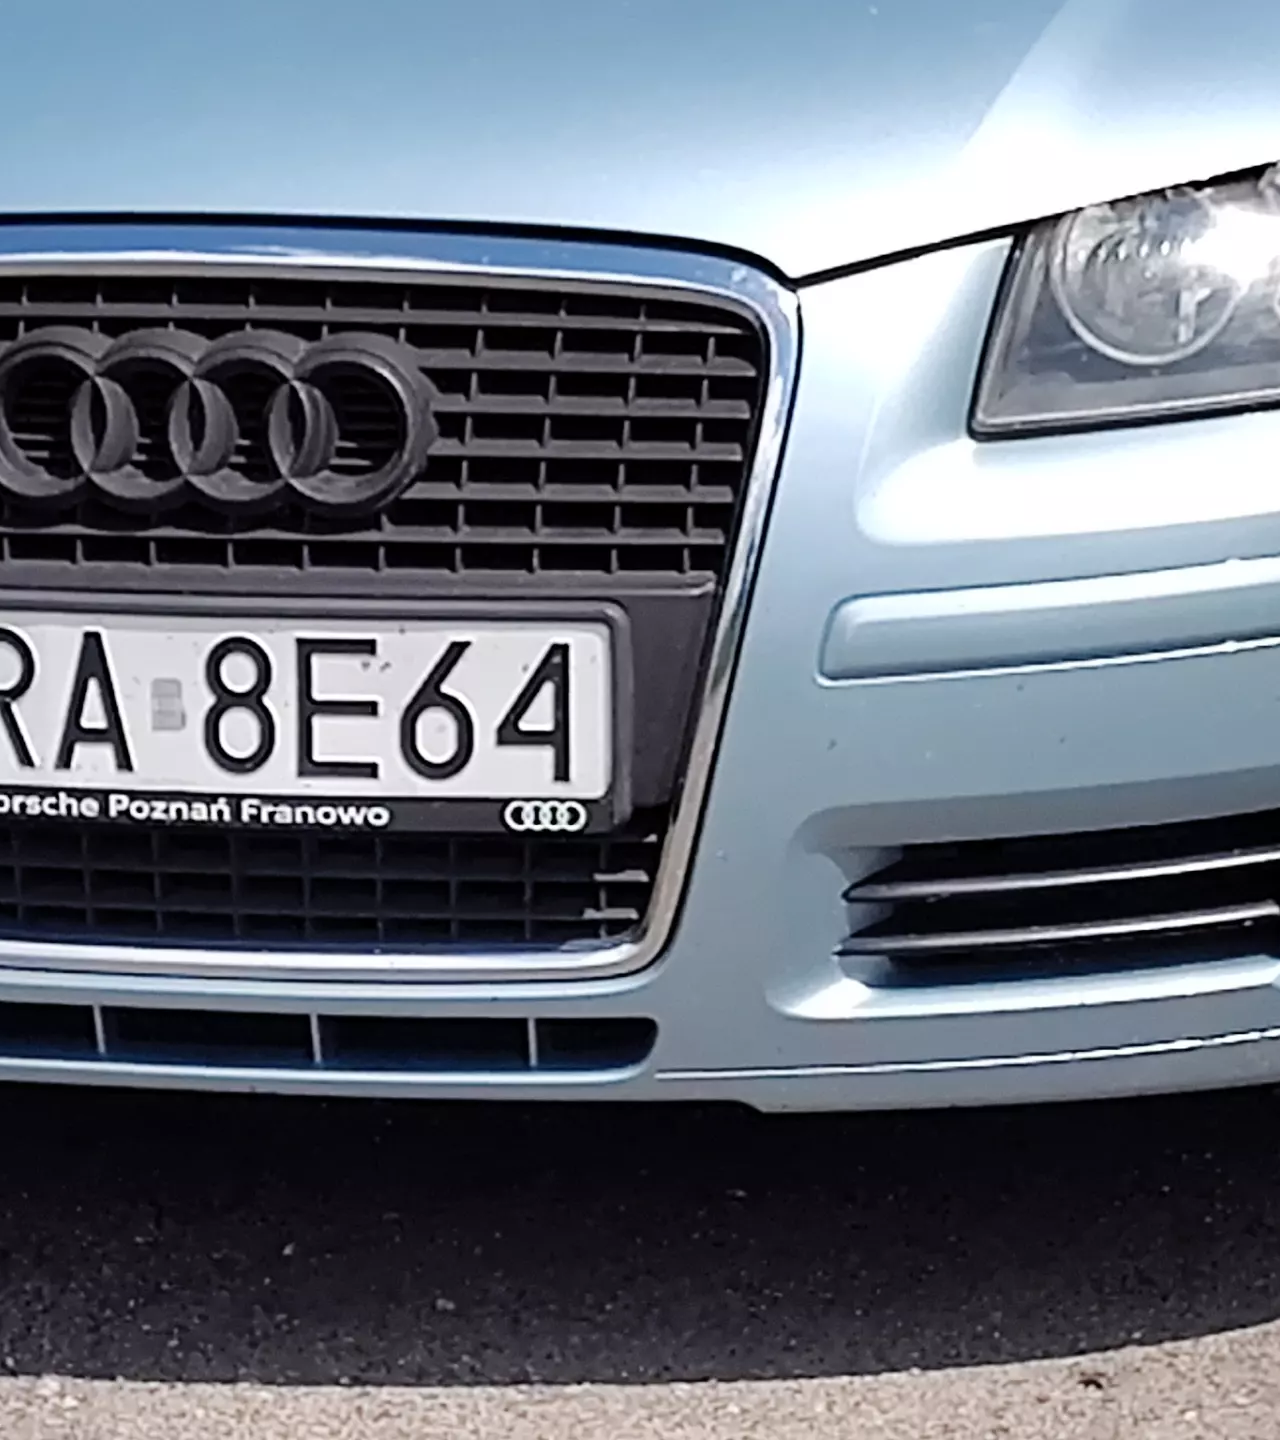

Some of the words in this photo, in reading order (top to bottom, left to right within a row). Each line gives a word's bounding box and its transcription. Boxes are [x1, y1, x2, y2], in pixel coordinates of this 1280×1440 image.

[204, 636, 571, 783] 8E64
[108, 792, 232, 822] Poznań
[240, 797, 391, 827] Franowo
